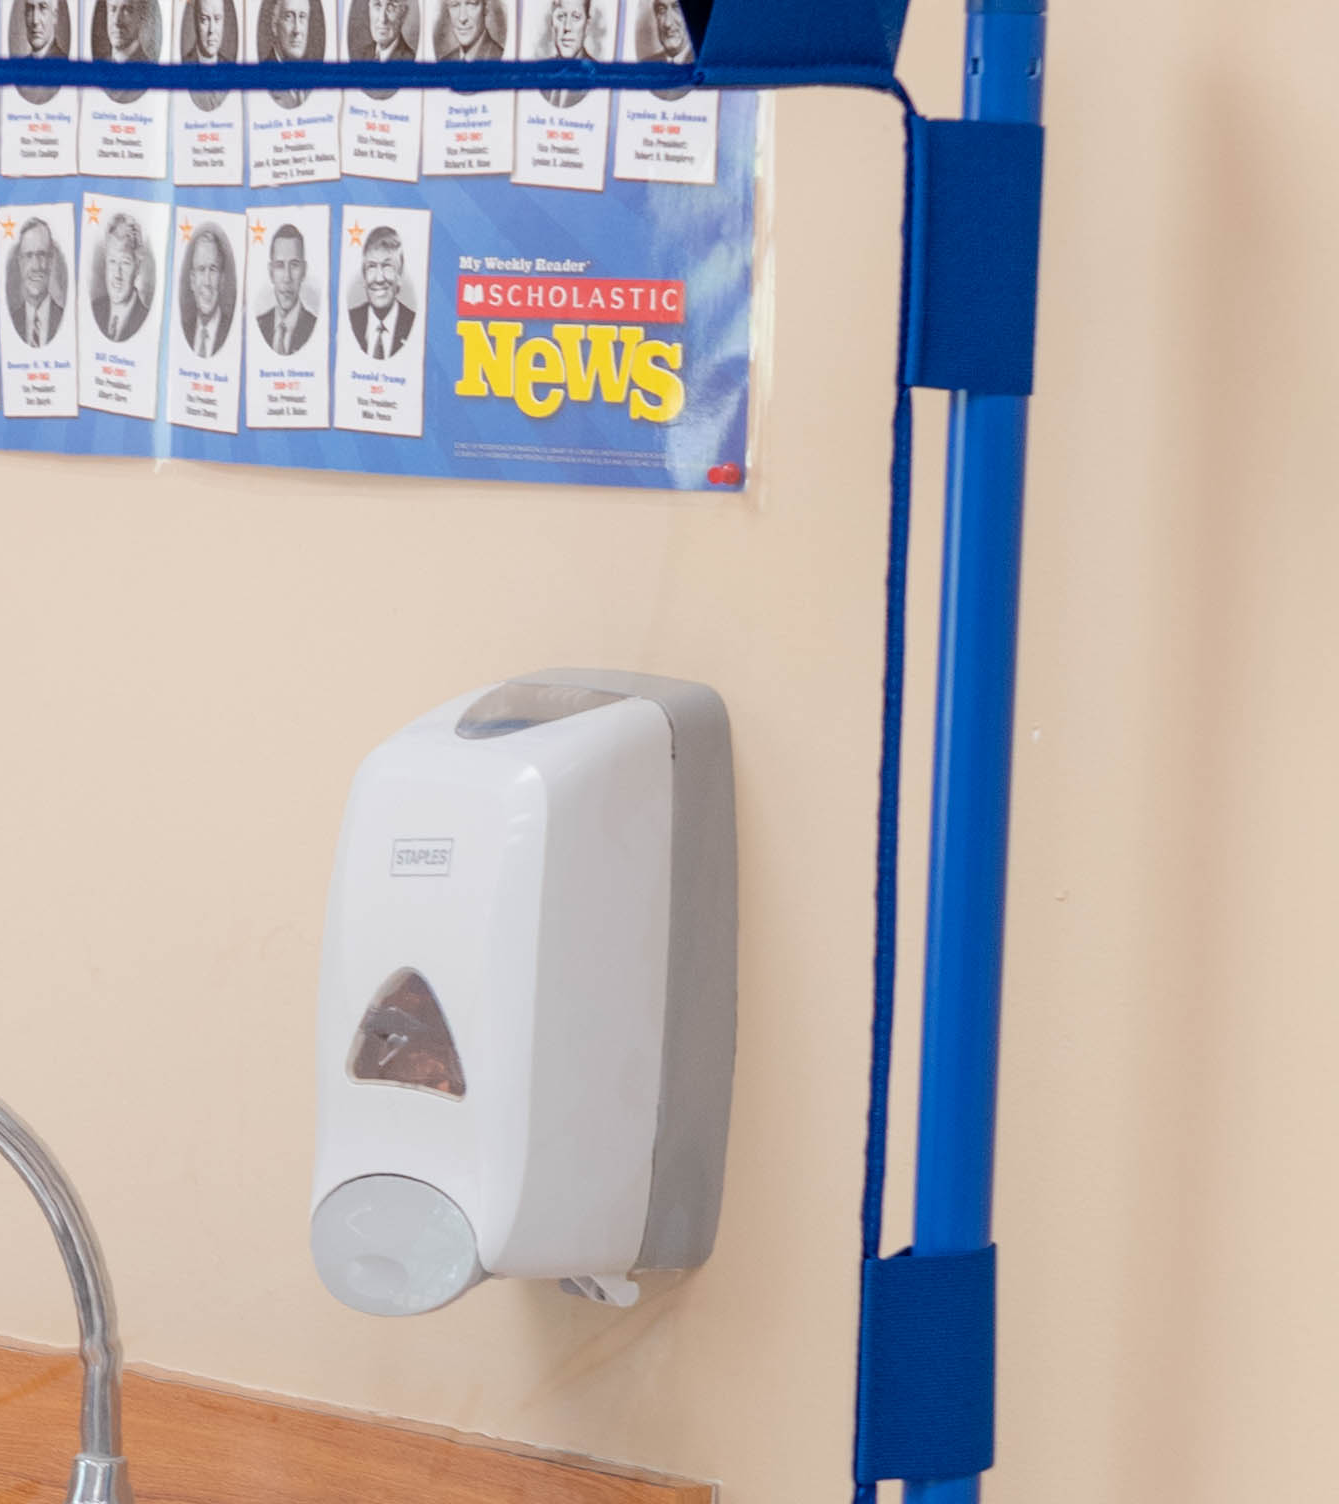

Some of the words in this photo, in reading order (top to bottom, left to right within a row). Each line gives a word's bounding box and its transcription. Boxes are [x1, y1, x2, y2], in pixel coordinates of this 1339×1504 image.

[459, 256, 481, 271] My
[485, 257, 531, 273] Weekly
[535, 259, 586, 272] Reader
[489, 284, 678, 310] SCHOLASTIC
[395, 849, 447, 864] STAPLES
